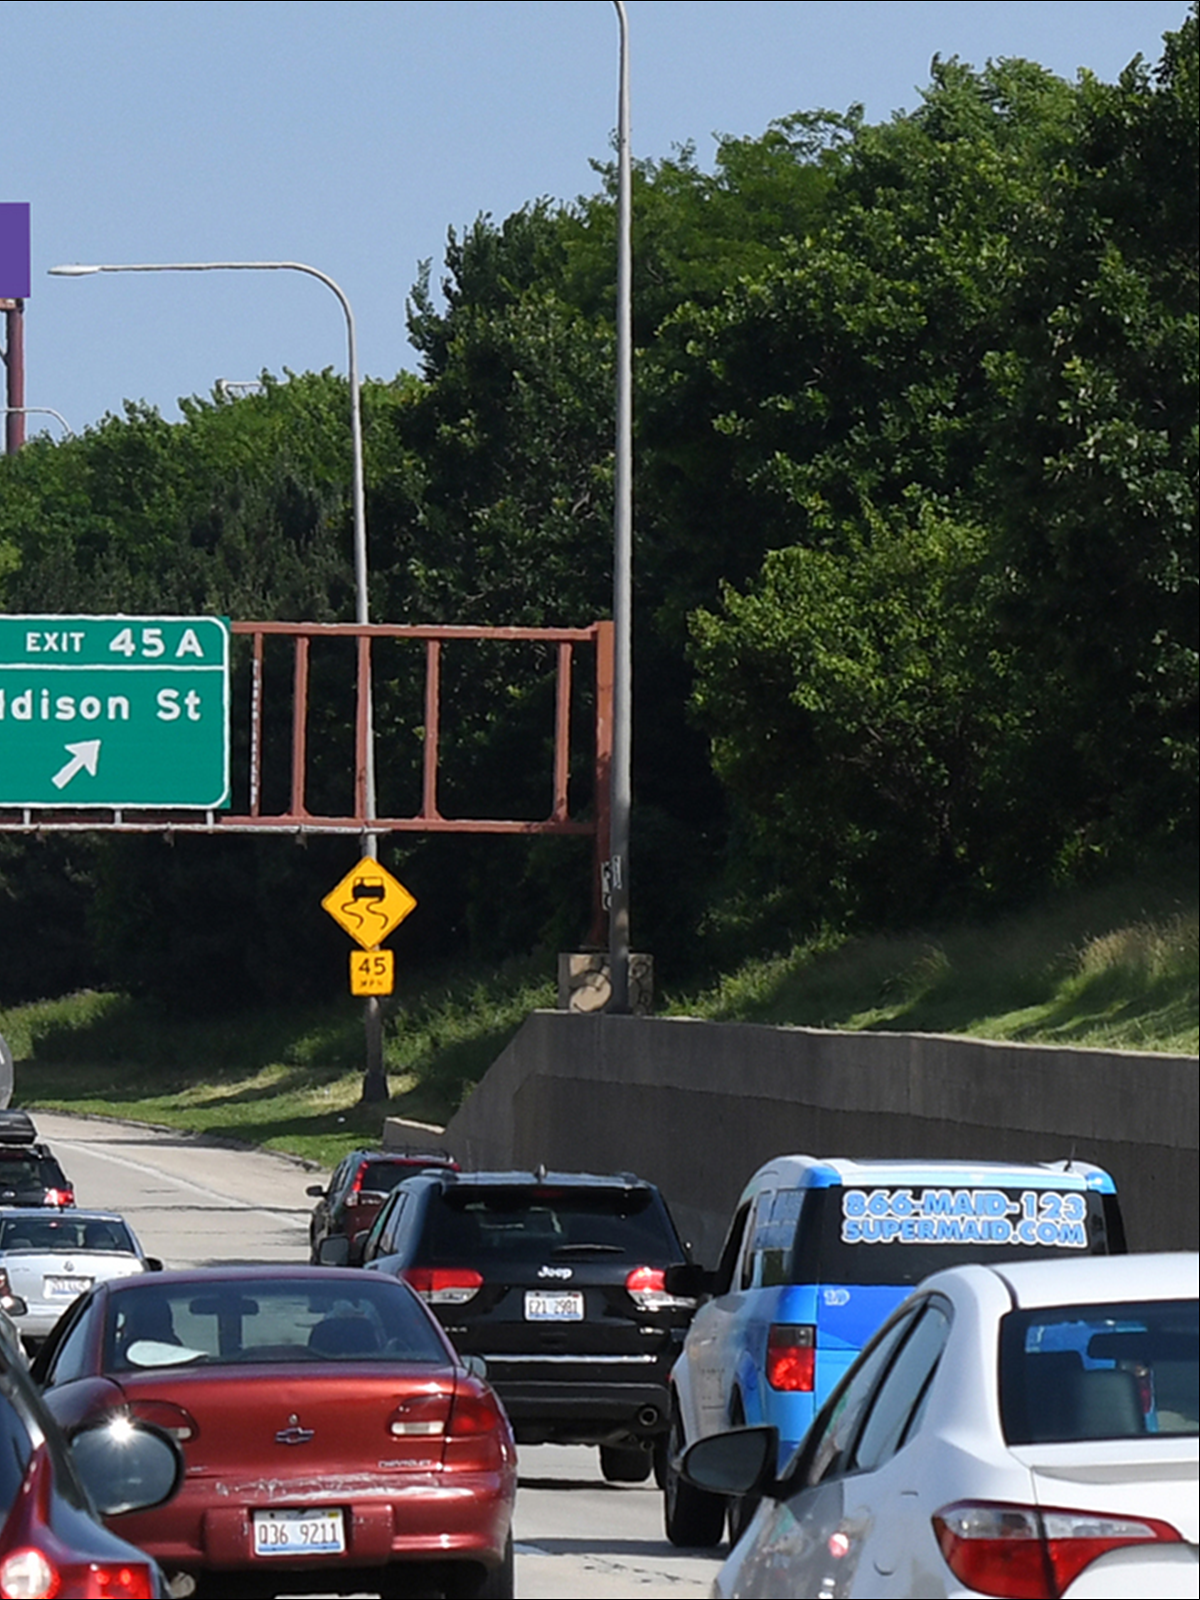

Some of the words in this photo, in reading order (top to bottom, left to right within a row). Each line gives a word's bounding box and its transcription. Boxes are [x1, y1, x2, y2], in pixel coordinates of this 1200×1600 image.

[25, 631, 86, 653] EXIT
[108, 629, 163, 657] 45
[175, 629, 205, 658] A
[156, 688, 202, 721] St
[358, 956, 387, 976] 45
[843, 1189, 1087, 1220] 866-MAID-123
[841, 1218, 1088, 1248] SUPERMAID.COM
[537, 1266, 574, 1280] Jeep
[299, 1522, 339, 1545] 9211
